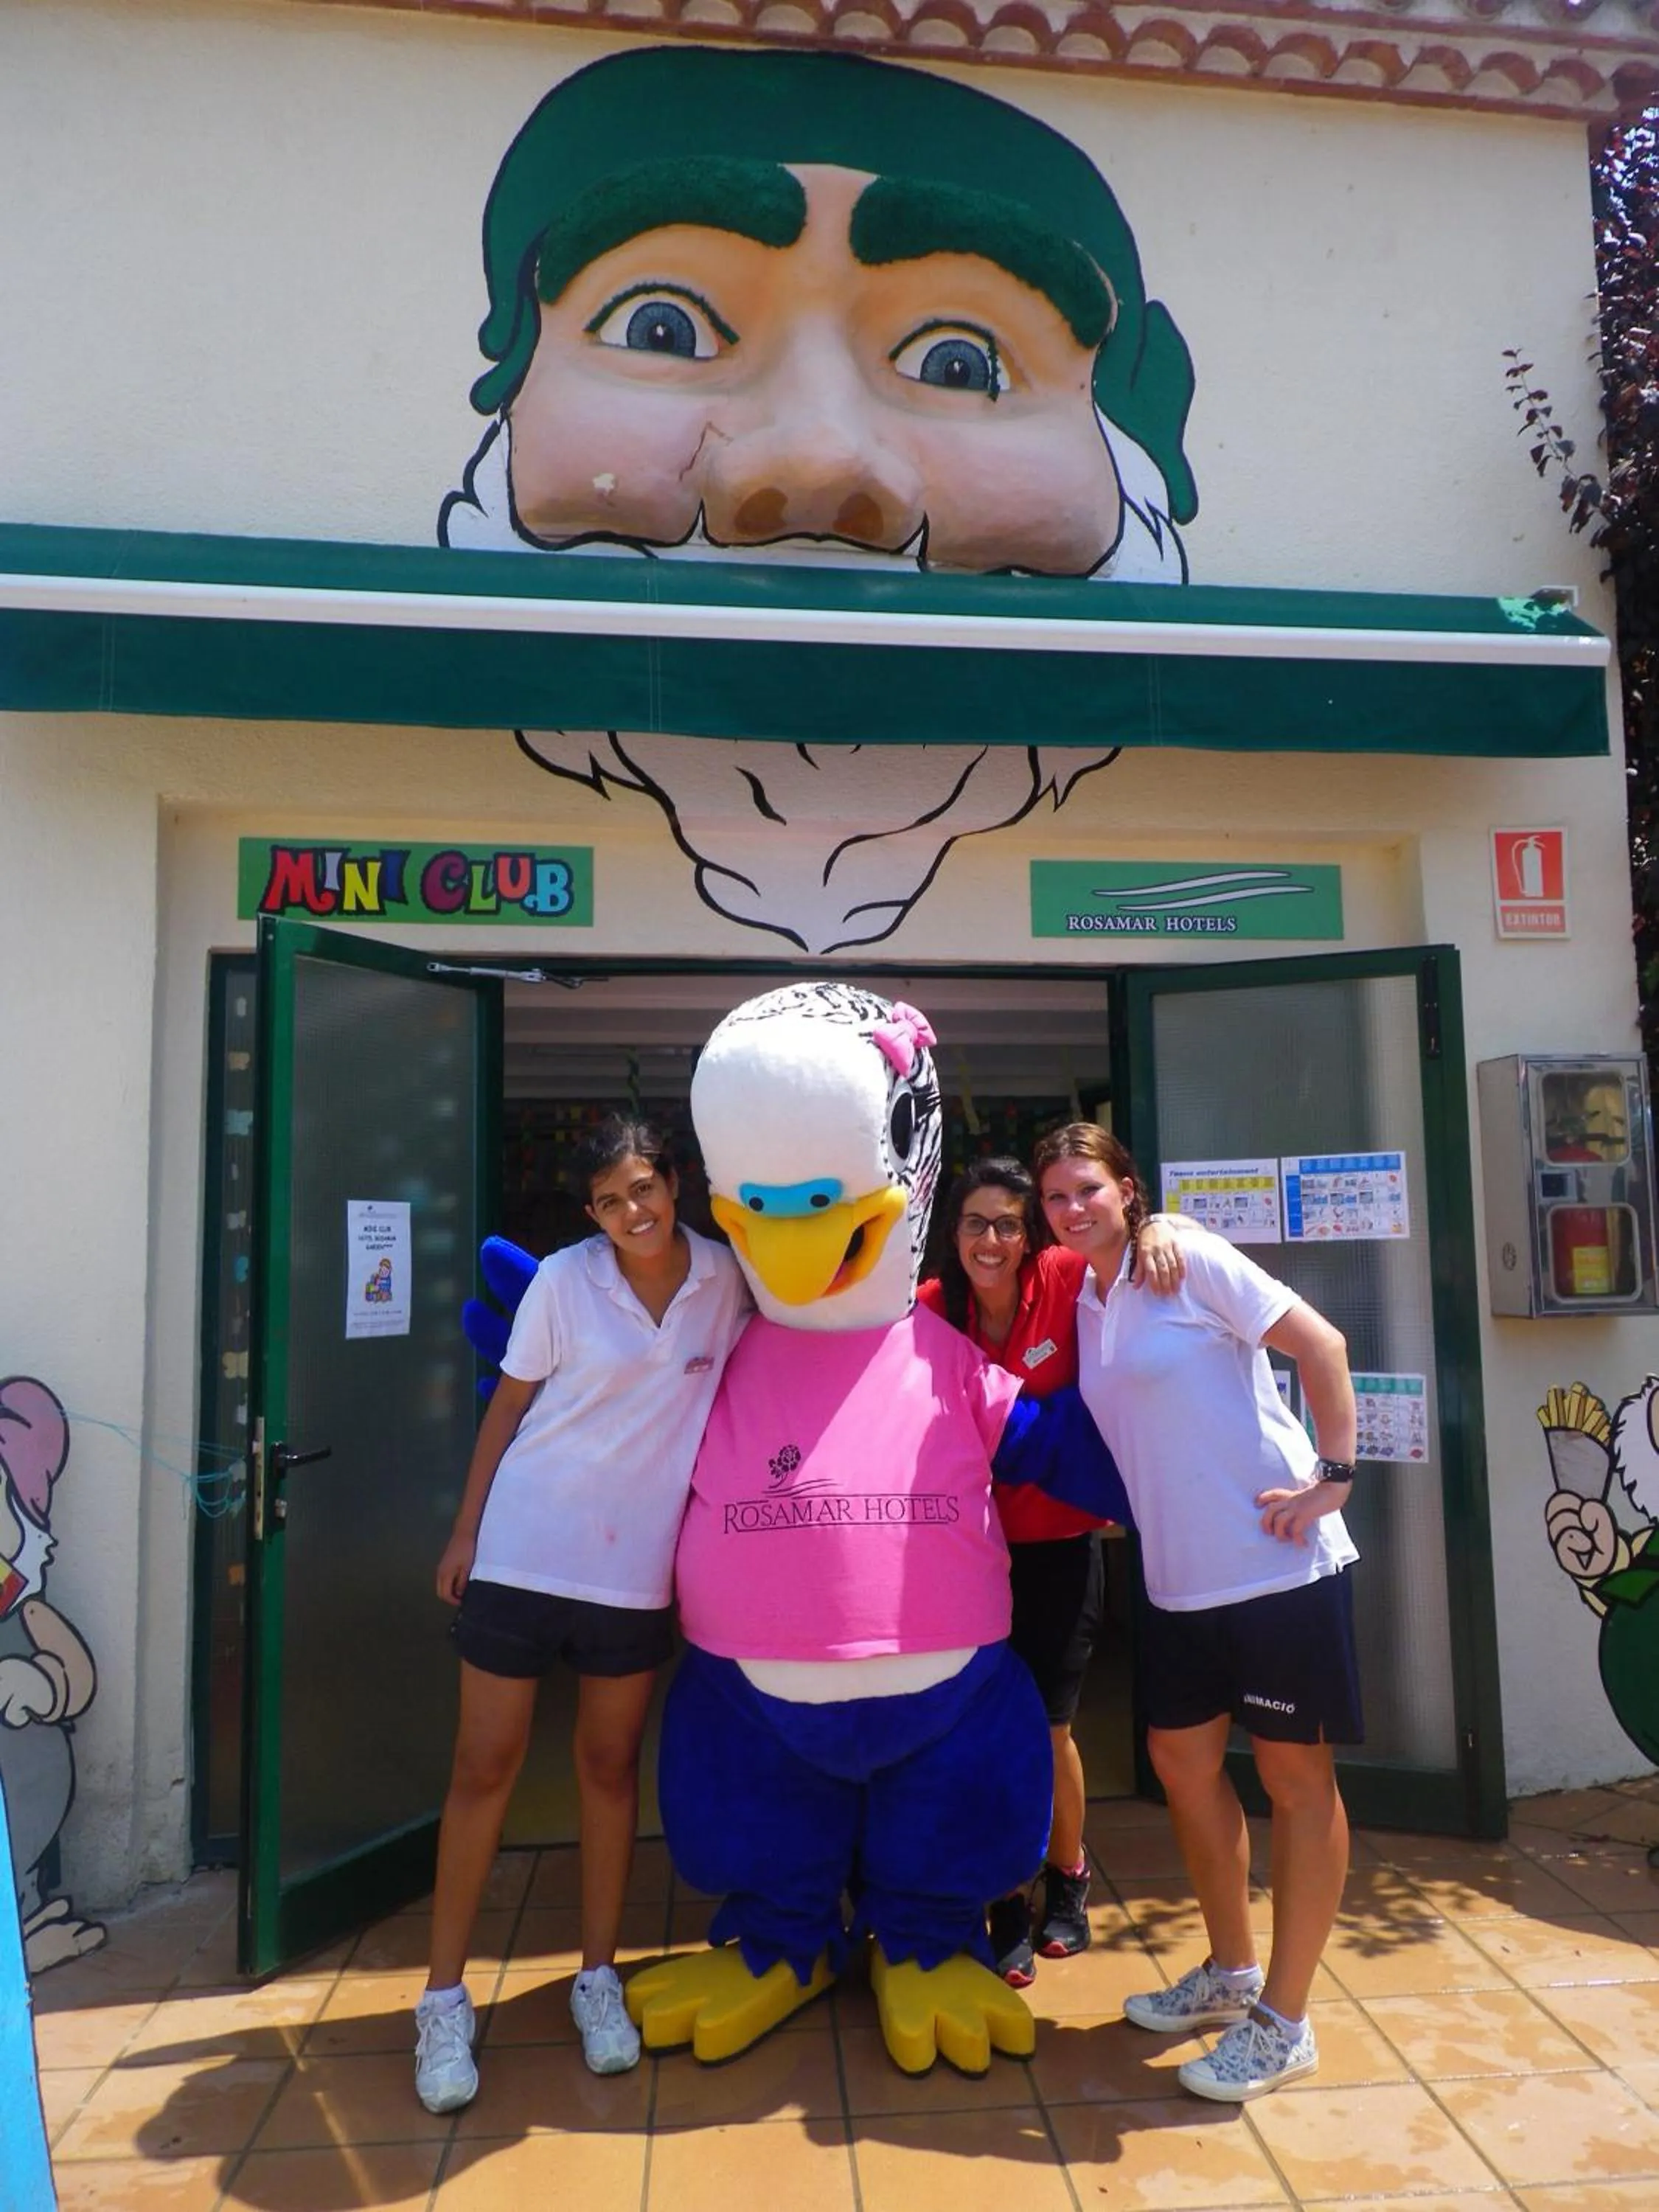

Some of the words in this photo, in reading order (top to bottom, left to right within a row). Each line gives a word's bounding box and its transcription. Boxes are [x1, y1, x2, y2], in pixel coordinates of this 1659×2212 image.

[259, 844, 411, 916] MINI
[420, 849, 574, 917] CLUB
[1067, 914, 1158, 931] ROSAMAR
[1165, 917, 1237, 933] HOTELS
[1505, 912, 1562, 927] EXTINTOR
[723, 1498, 854, 1534] ROSAMAR
[864, 1495, 960, 1523] HOTELS
